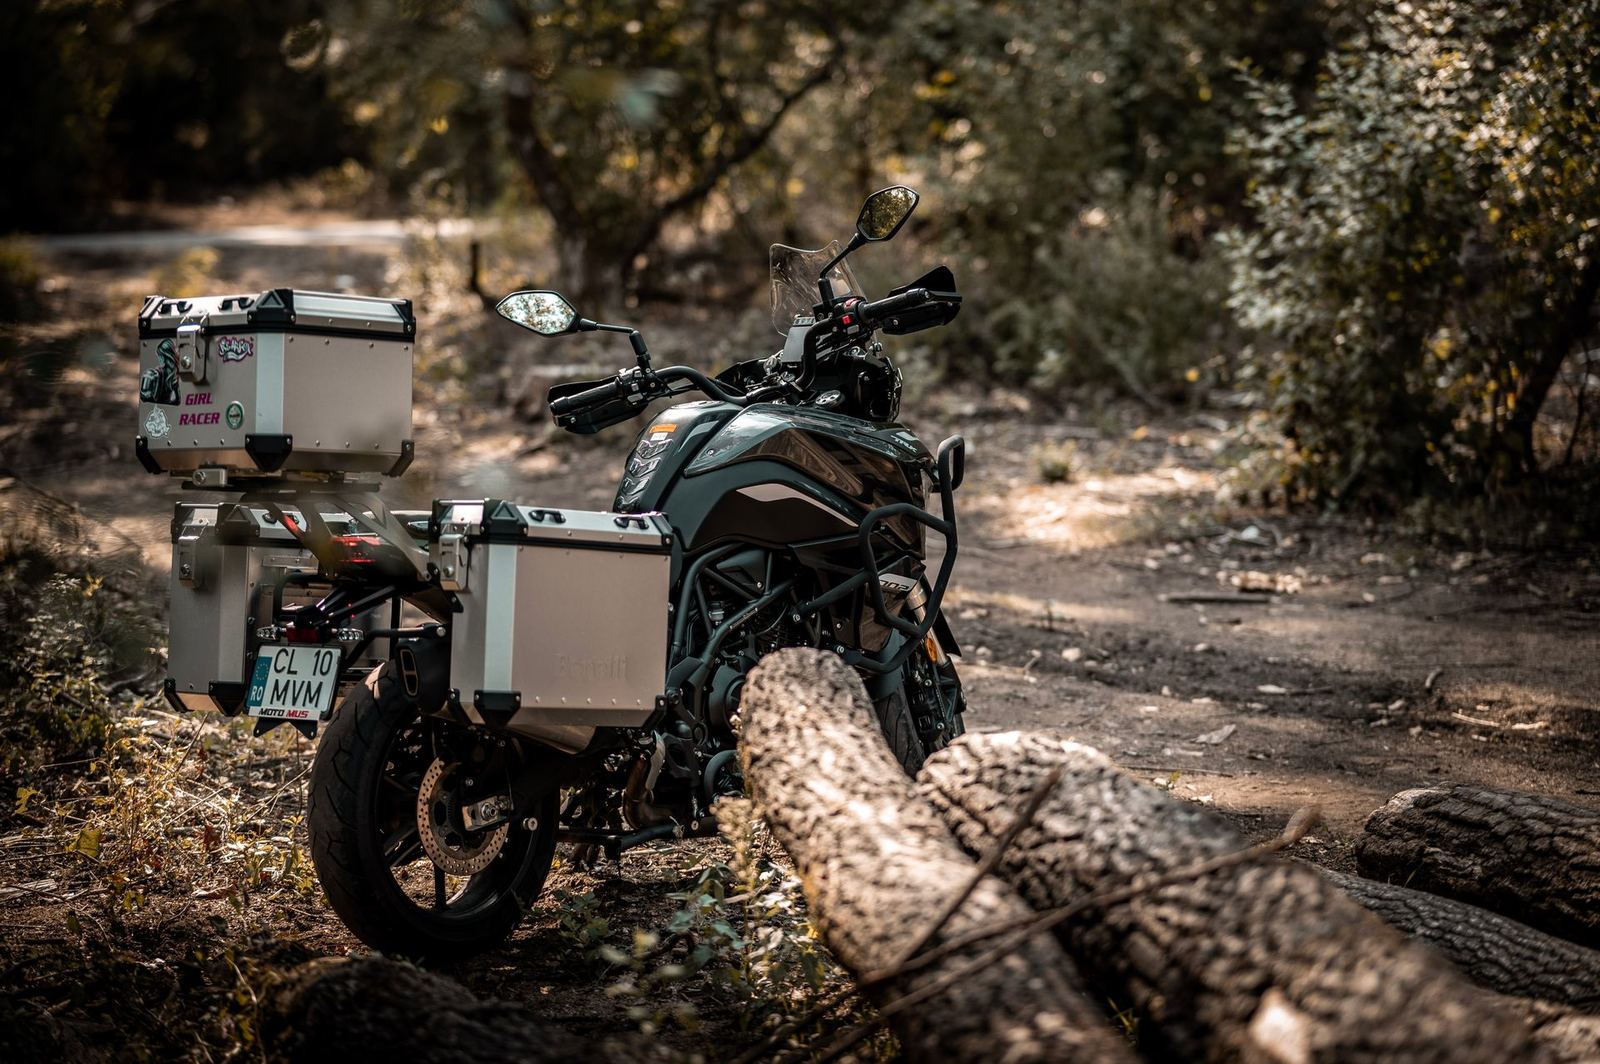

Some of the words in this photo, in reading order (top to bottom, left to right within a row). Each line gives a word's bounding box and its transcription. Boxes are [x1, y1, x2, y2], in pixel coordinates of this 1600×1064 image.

[185, 392, 213, 405] GIRL
[178, 412, 221, 425] RACER
[273, 648, 298, 675] CL
[312, 649, 333, 676] 10
[250, 685, 264, 702] RO
[269, 678, 323, 708] MVM
[258, 708, 285, 717] MOTO
[286, 709, 309, 719] MUS
